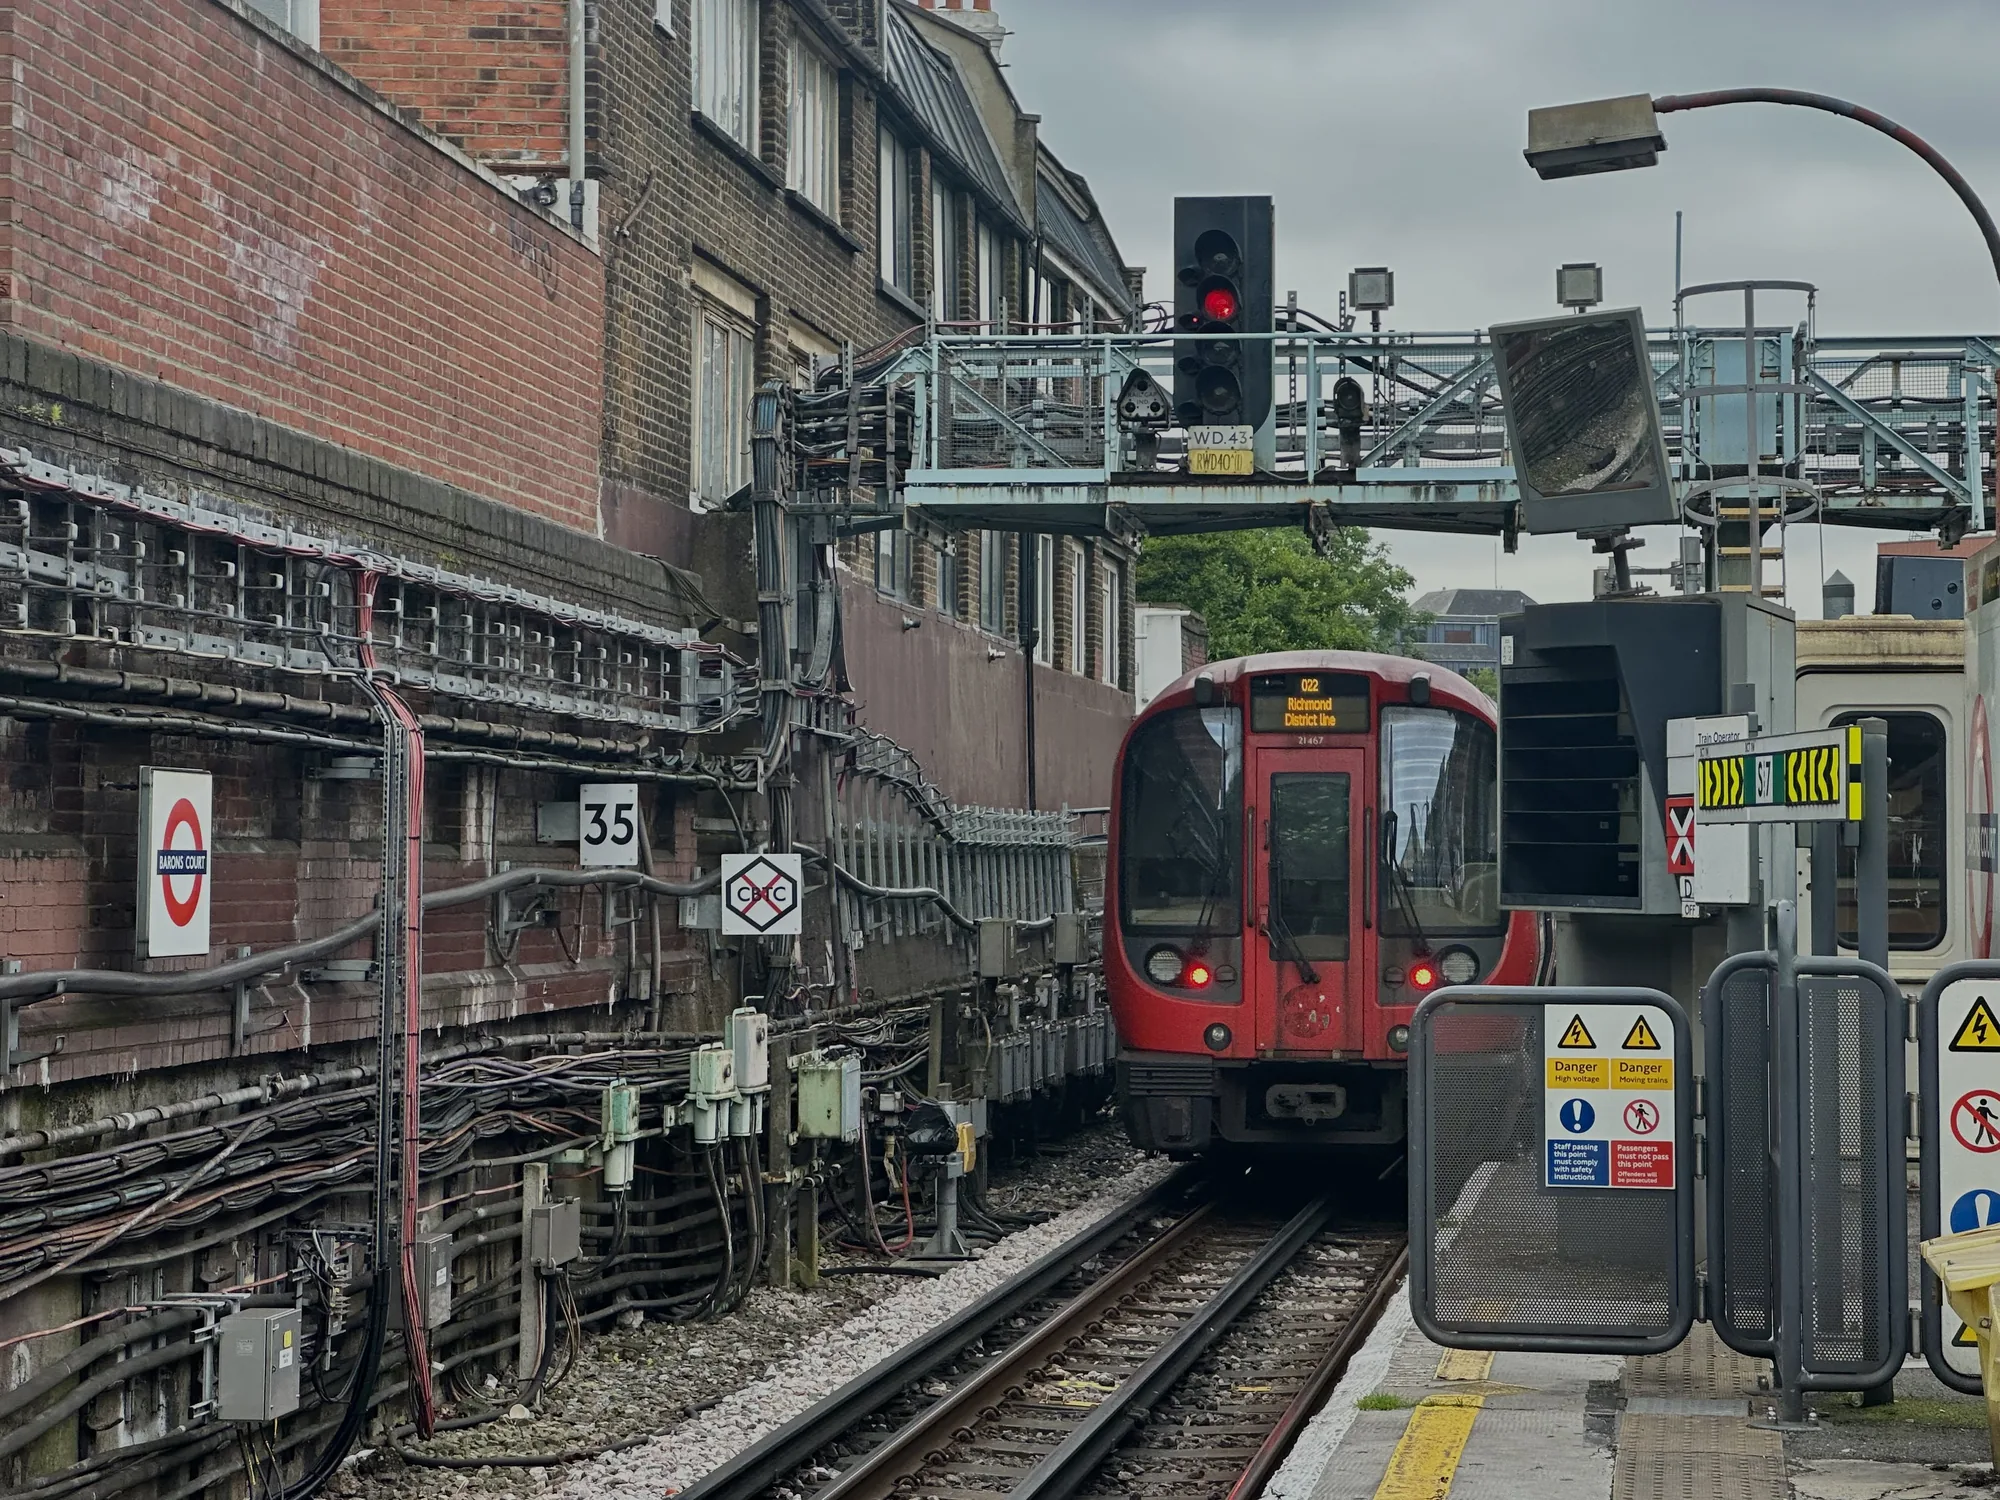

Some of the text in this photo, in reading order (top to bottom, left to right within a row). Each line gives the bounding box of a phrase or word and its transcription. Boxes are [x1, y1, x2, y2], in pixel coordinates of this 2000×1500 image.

[1193, 431, 1248, 445] WD.43
[1301, 678, 1319, 692] 022
[1287, 697, 1333, 711] Richmond
[1284, 713, 1337, 727] District line
[1298, 736, 1324, 745] 21467
[1698, 731, 1740, 744] Train Operator
[583, 803, 634, 846] 35
[159, 855, 206, 870] BARONS COURT
[737, 886, 787, 902] CBTC
[1684, 904, 1696, 916] OFF
[1555, 1061, 1598, 1074] Danger
[1619, 1062, 1663, 1075] Danger
[1555, 1075, 1600, 1083] High voltage
[1619, 1076, 1669, 1084] Moving trains
[1553, 1143, 1598, 1152] Staff passing
[1617, 1144, 1658, 1153] Passengers
[1568, 1151, 1587, 1159] point
[1572, 1159, 1598, 1167] comply
[1632, 1161, 1653, 1169] point
[1571, 1166, 1593, 1174] safety
